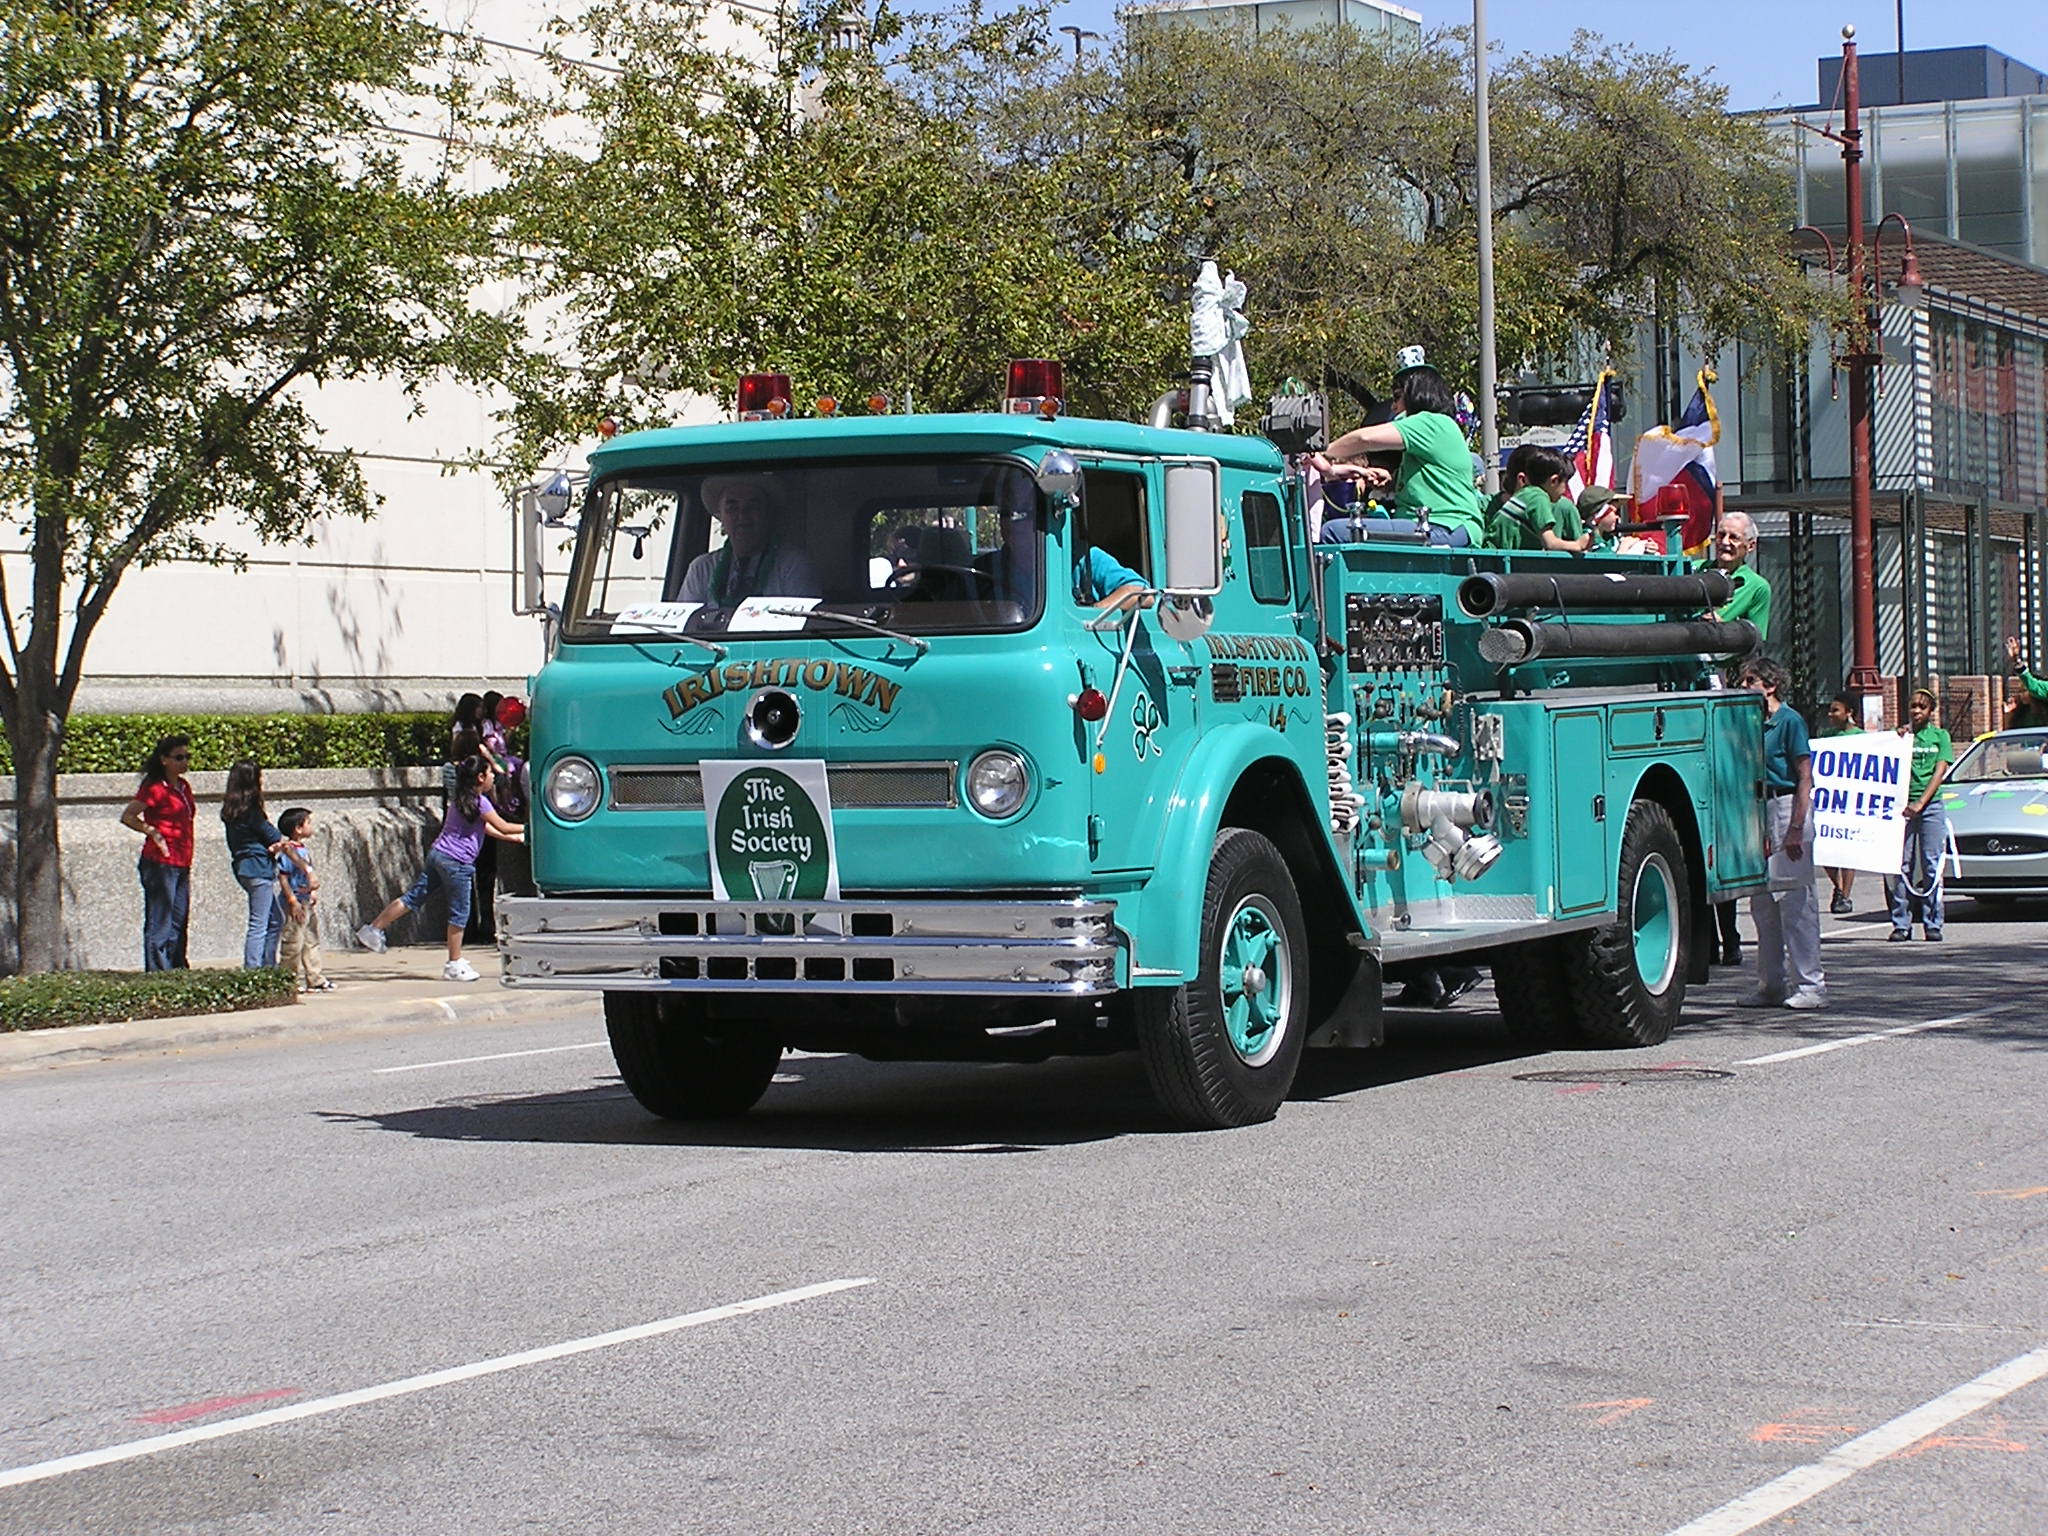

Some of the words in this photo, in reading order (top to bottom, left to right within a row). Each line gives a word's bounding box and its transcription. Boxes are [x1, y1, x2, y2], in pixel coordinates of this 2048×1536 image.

[1501, 438, 1521, 446] 1200
[662, 657, 903, 721] IRISHTOWN
[1240, 666, 1281, 697] FIRE
[1283, 666, 1311, 698] CO.
[743, 777, 785, 804] The
[741, 805, 794, 830] Irish
[1855, 792, 1895, 820] LEE
[730, 828, 812, 863] Society
